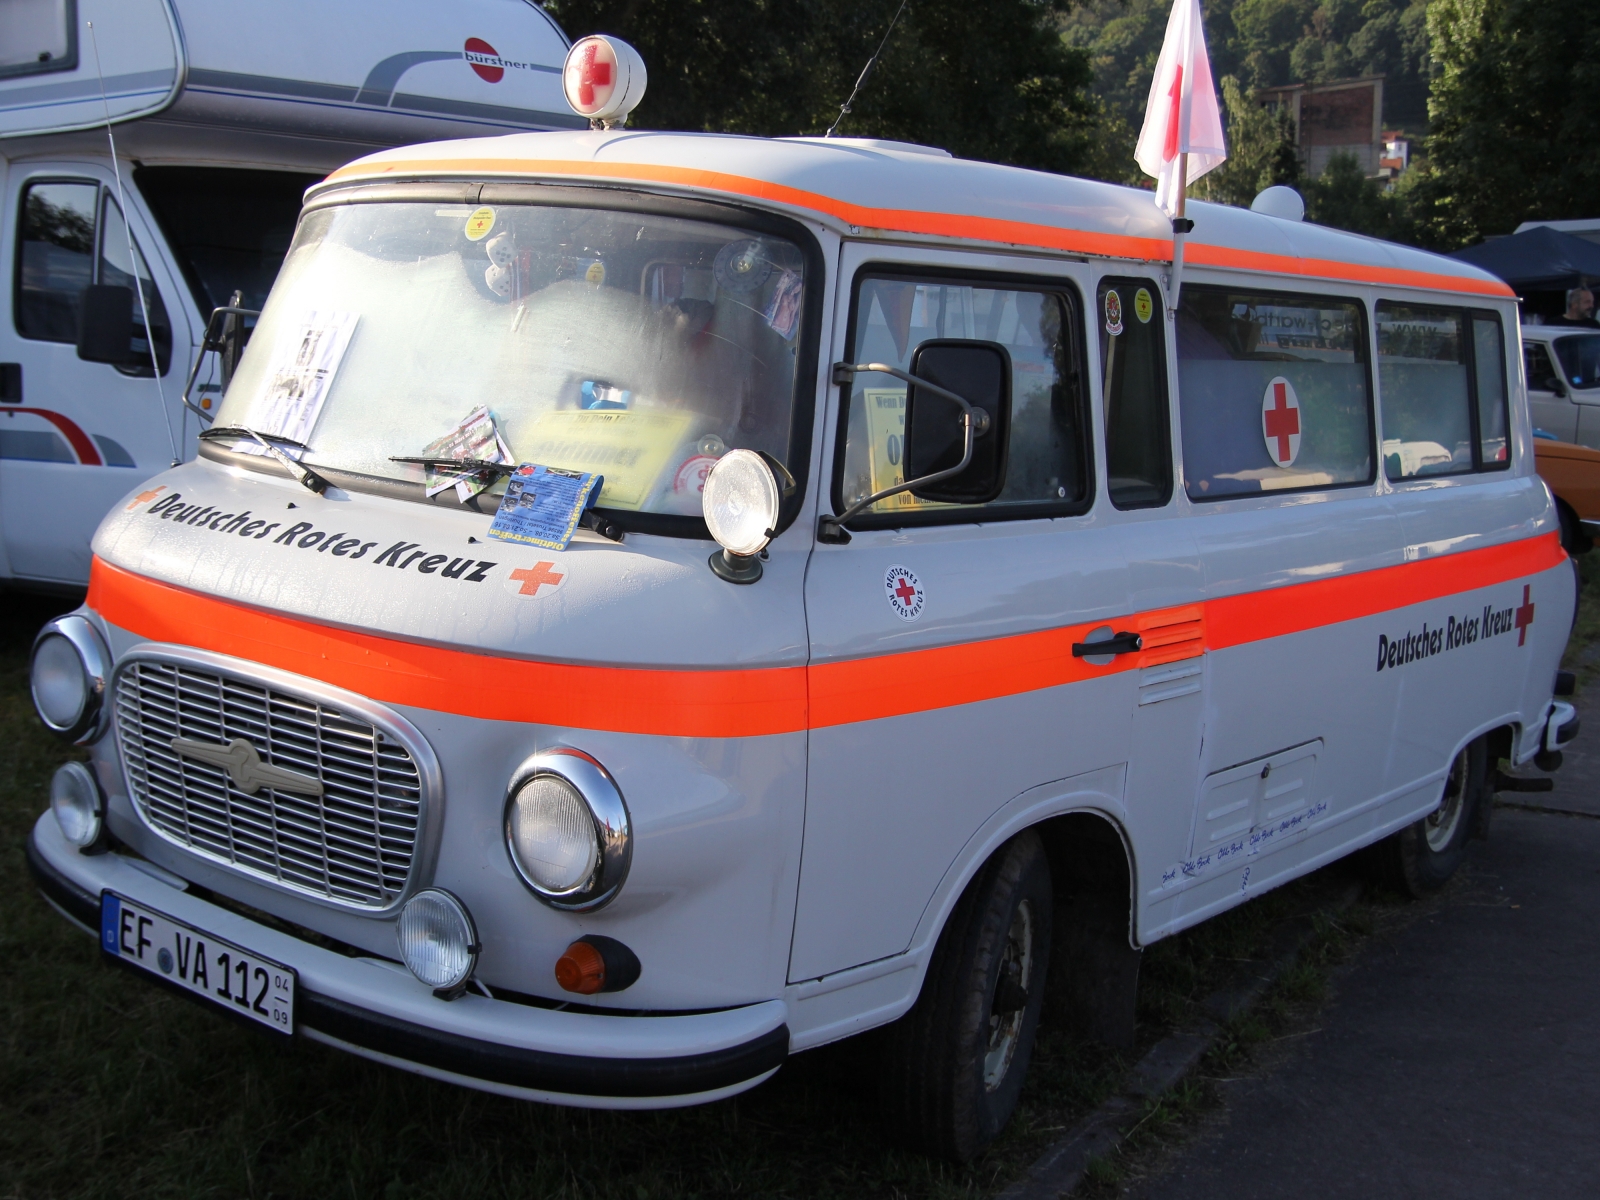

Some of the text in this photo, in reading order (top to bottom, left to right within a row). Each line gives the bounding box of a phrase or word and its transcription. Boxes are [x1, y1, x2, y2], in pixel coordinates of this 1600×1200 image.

[464, 51, 528, 69] bürstner
[876, 396, 897, 409] Wenn
[147, 493, 498, 583] Deutsches Rotes Kreuz
[489, 528, 565, 551] Oldtimertreffen
[886, 568, 918, 589] DEUTSCHES
[889, 590, 924, 617] ROTES KREUZ
[1376, 605, 1514, 672] Deutsches Rotes Kreuz
[120, 907, 270, 1018] EF VA 112
[275, 975, 289, 992] 04
[273, 1008, 288, 1025] 09
